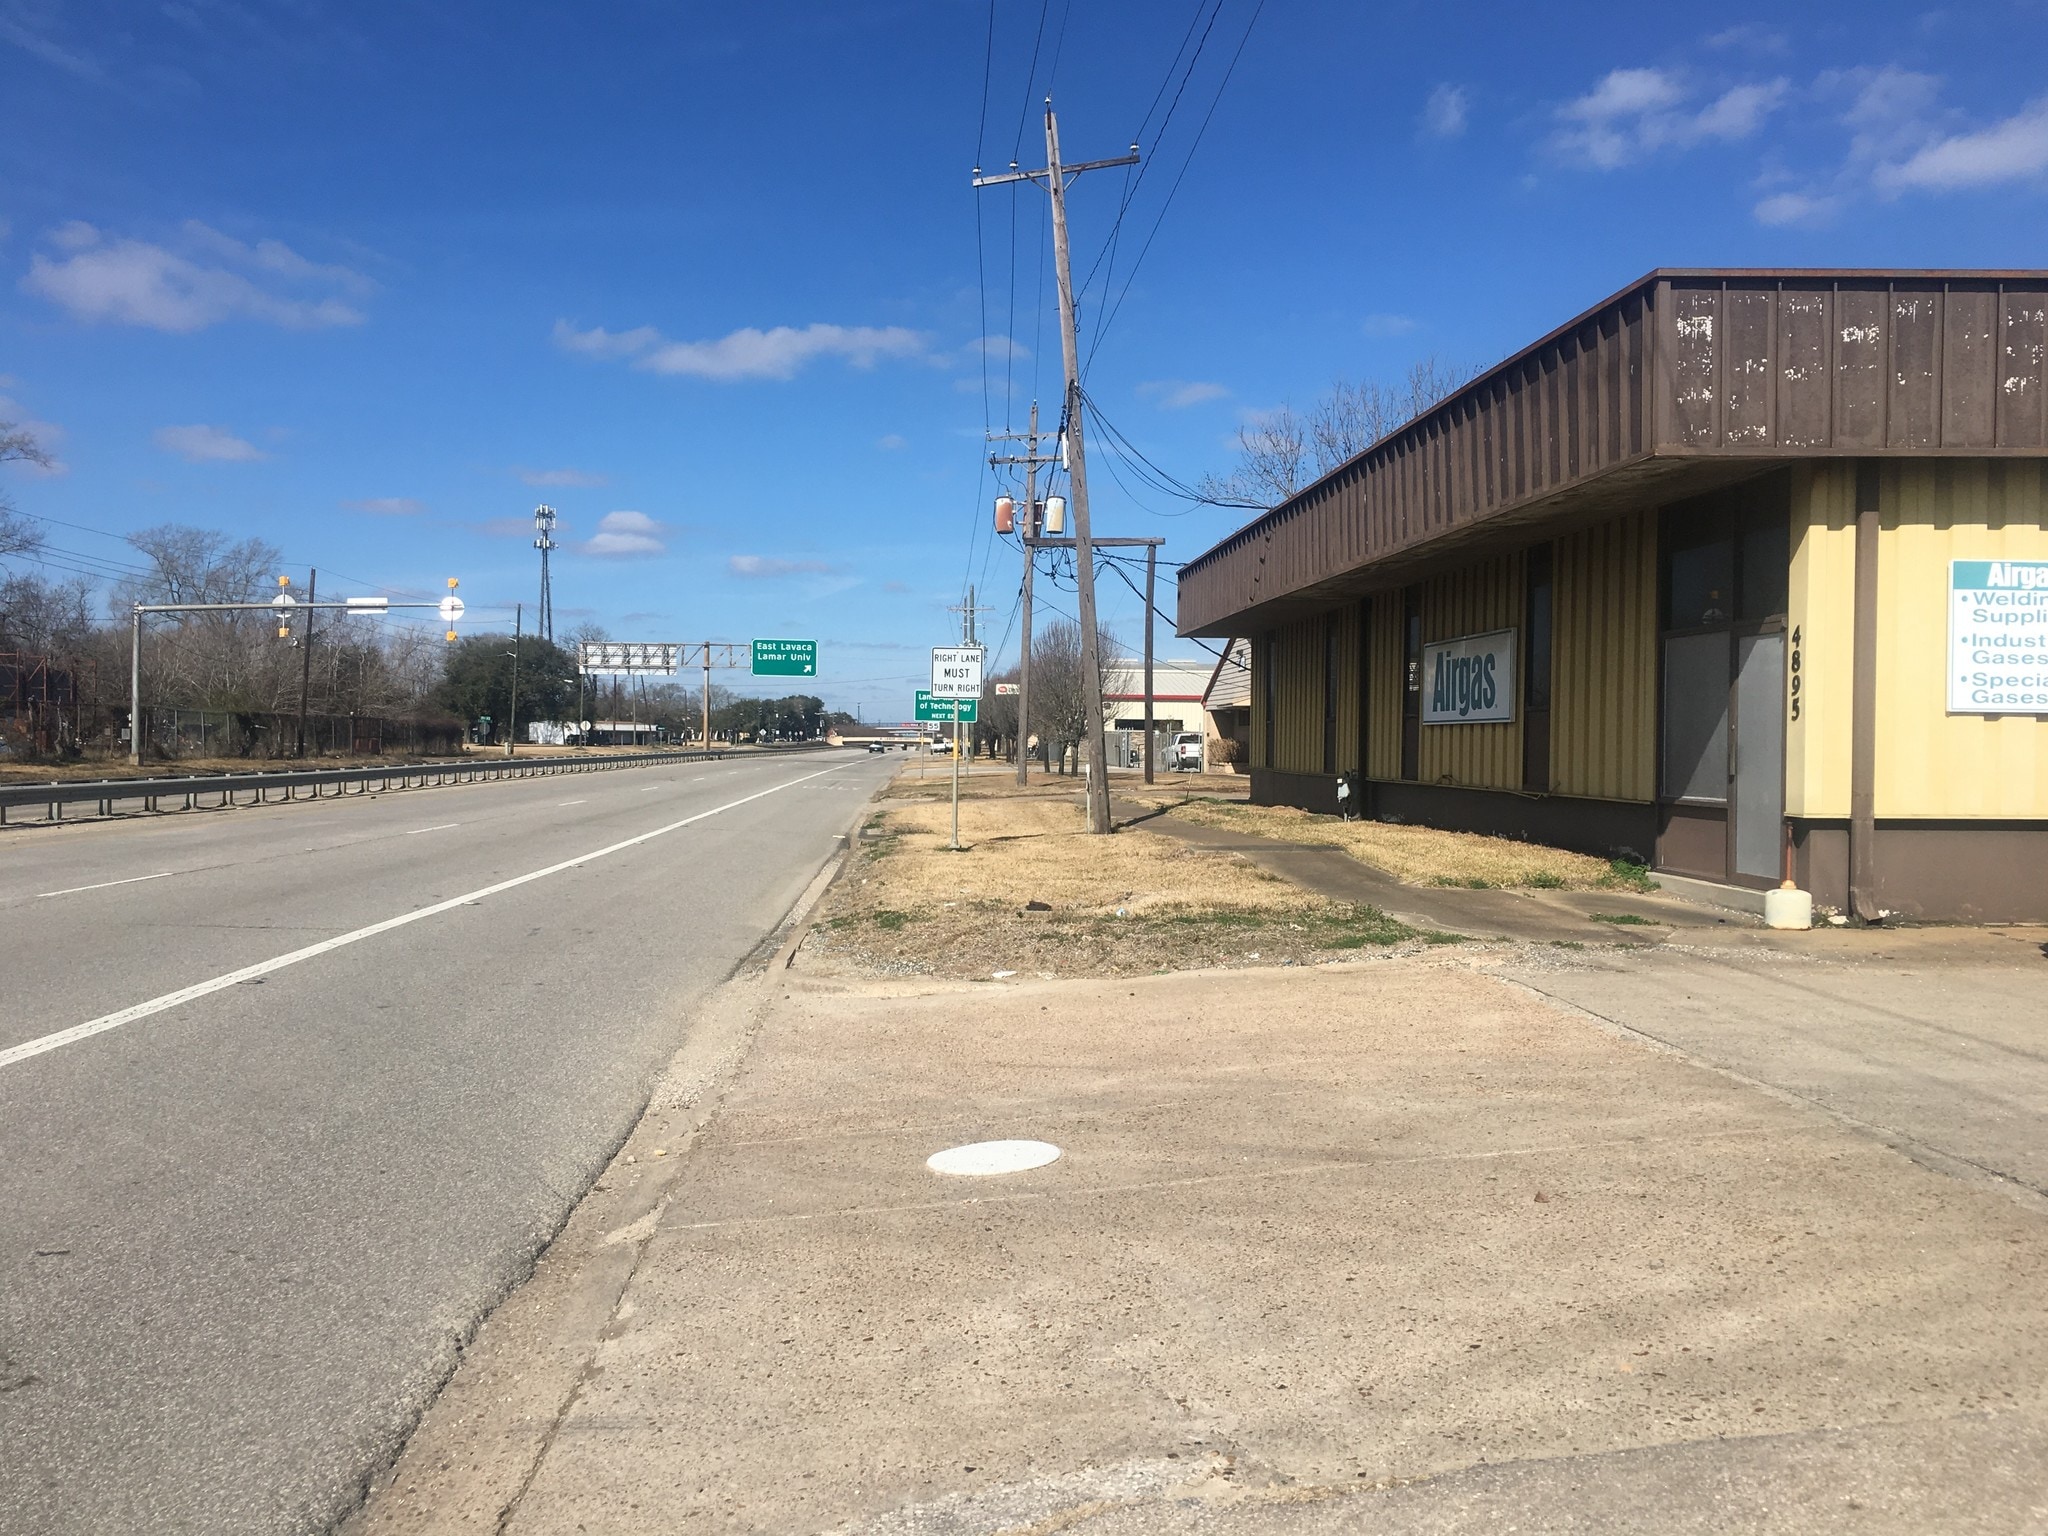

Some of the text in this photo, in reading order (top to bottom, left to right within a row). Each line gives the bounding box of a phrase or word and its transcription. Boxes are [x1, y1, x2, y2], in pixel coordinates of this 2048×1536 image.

[1987, 562, 2048, 590] Airga
[1972, 608, 2047, 626] Suppli
[757, 642, 812, 651] East Lavaca
[1972, 633, 2046, 648] Indust
[758, 653, 811, 661] Lamar Univ
[934, 654, 980, 663] RIGHT LANE
[1972, 650, 2048, 665] Gases
[944, 668, 970, 678] MUST
[1791, 624, 1801, 722] 4895
[934, 683, 980, 692] TURN RIGHT
[1432, 651, 1496, 717] Airgas
[1971, 689, 2048, 705] Gases
[930, 702, 972, 712] Technoogy
[928, 722, 939, 730] 55
